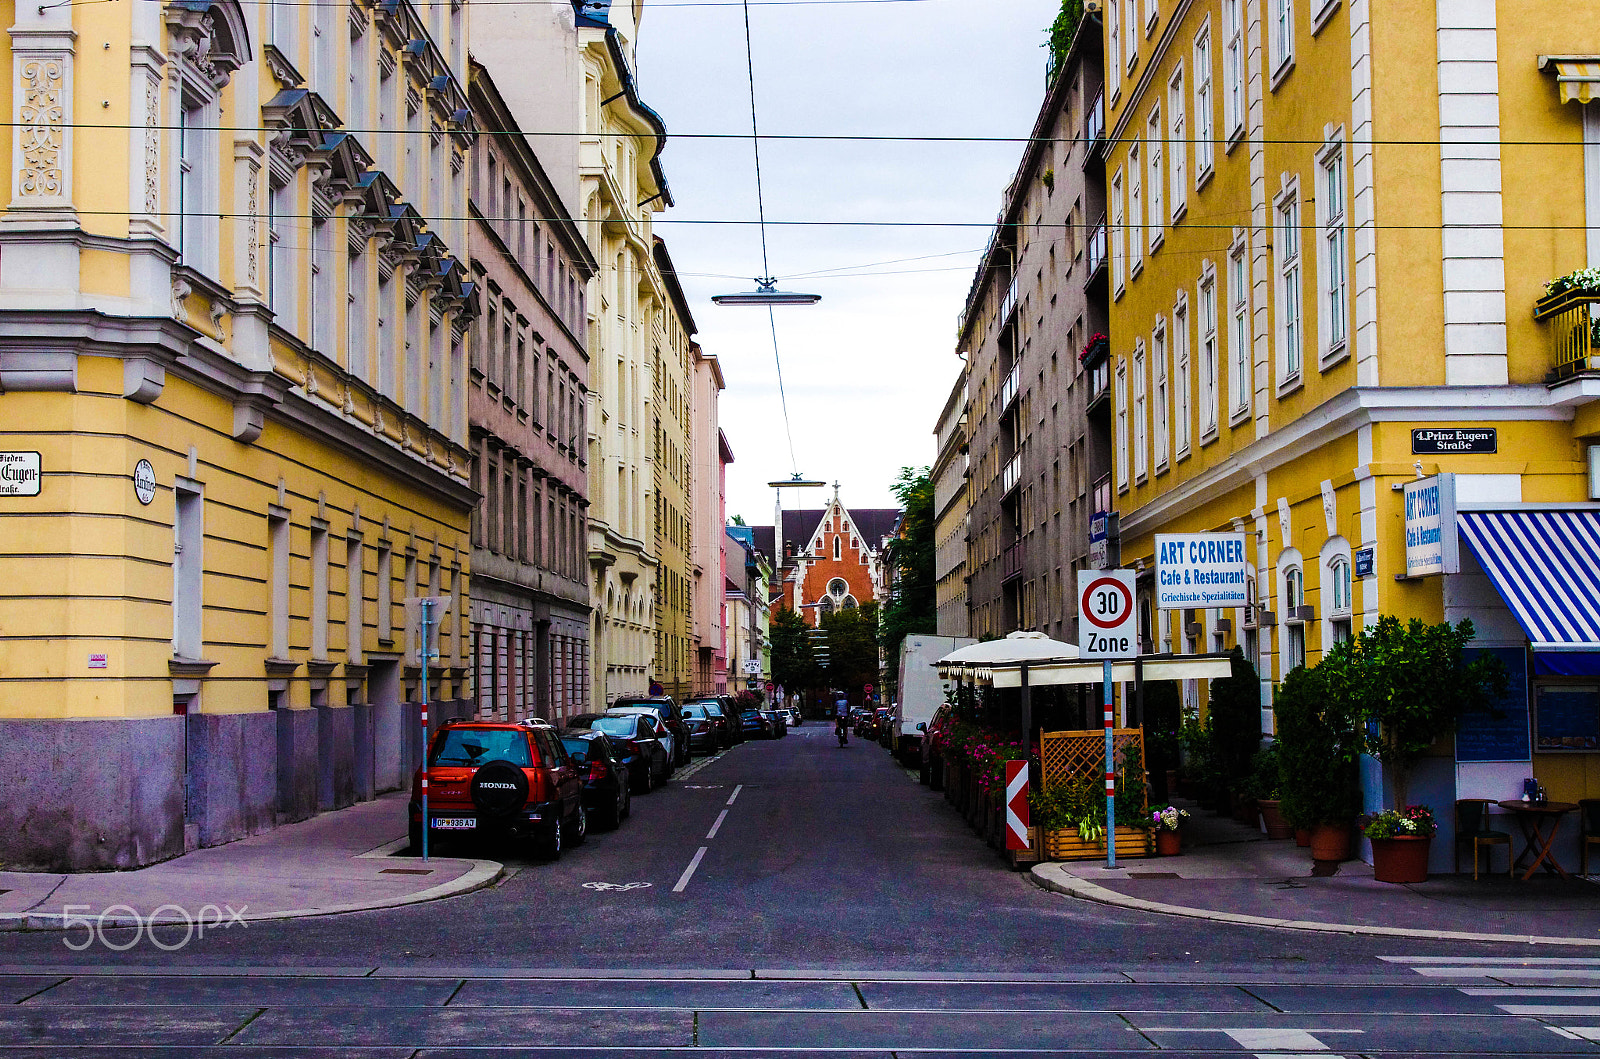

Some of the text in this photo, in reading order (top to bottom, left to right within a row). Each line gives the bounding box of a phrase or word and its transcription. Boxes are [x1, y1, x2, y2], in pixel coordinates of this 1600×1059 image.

[1436, 441, 1472, 450] Straße
[1, 463, 38, 484] Eugen-
[1160, 540, 1244, 565] ART CORNER
[1160, 568, 1245, 586] Cafe & Restaurant
[1096, 591, 1118, 615] 30
[1161, 590, 1245, 603] Griechische Spezialitäten
[1087, 632, 1129, 653] Zone
[480, 782, 517, 790] HONDA
